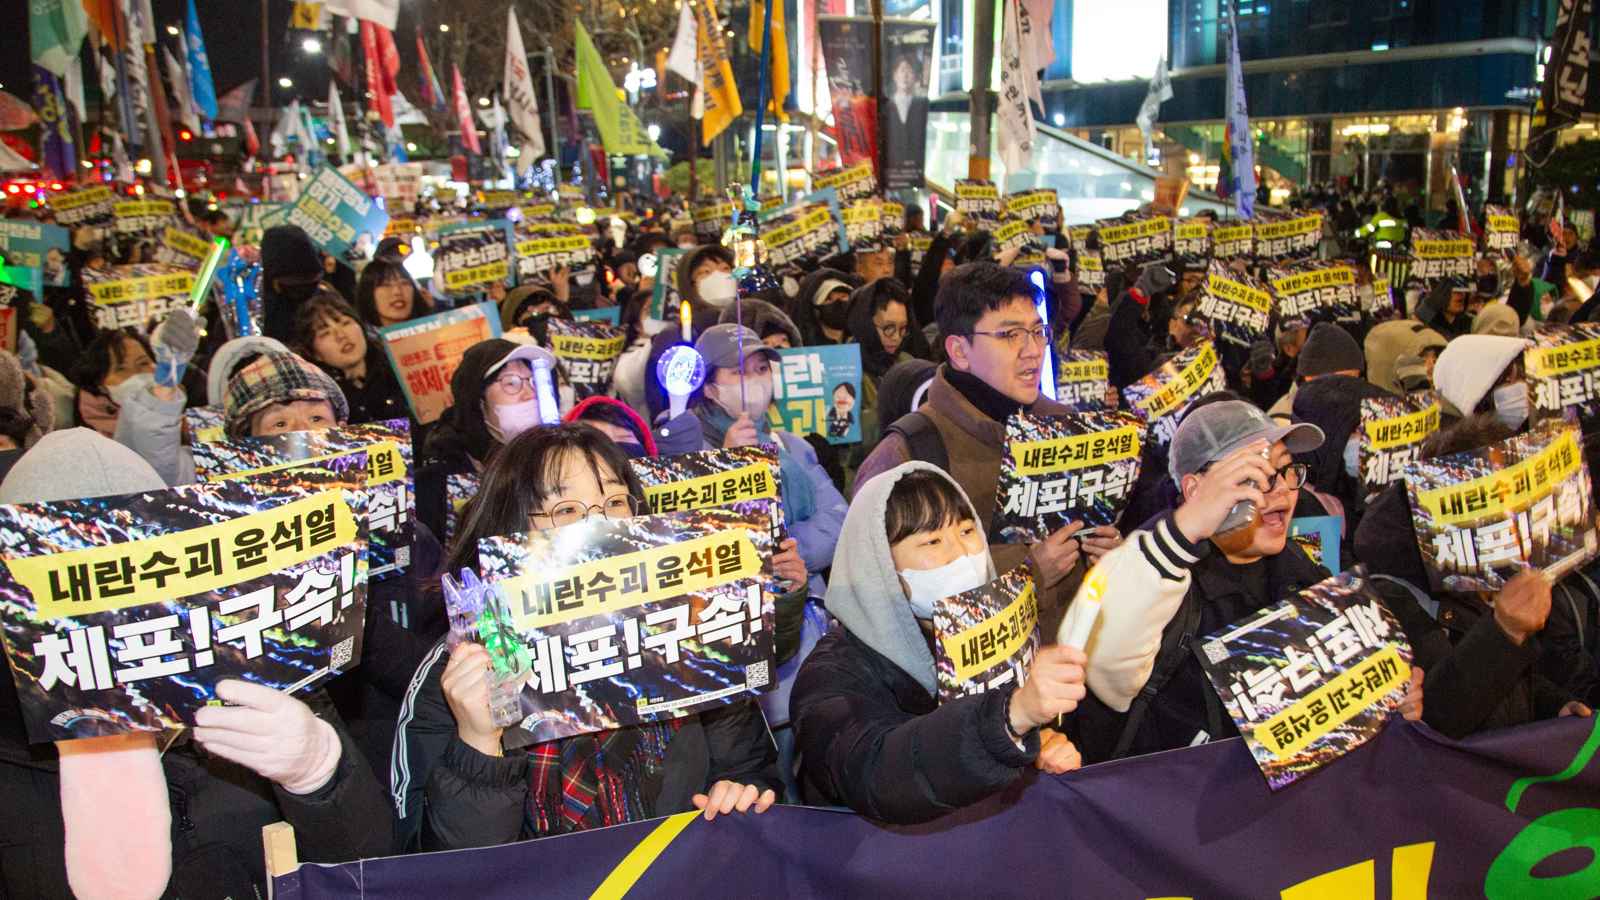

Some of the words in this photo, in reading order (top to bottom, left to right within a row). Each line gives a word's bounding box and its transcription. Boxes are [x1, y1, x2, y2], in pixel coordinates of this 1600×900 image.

[1024, 440, 1089, 468] 내란수괴
[1092, 433, 1134, 459] 윤석열
[721, 470, 767, 502] 윤석열
[1439, 469, 1531, 515] 내란수괴
[47, 537, 224, 603] 내란수괴
[231, 503, 338, 570] 윤석열
[520, 561, 648, 616] 내란수괴
[655, 539, 744, 589] 윤석열
[960, 612, 1021, 668] 내란수괴
[1325, 655, 1399, 715] 내란수괴
[1268, 696, 1330, 750] 윤석열
